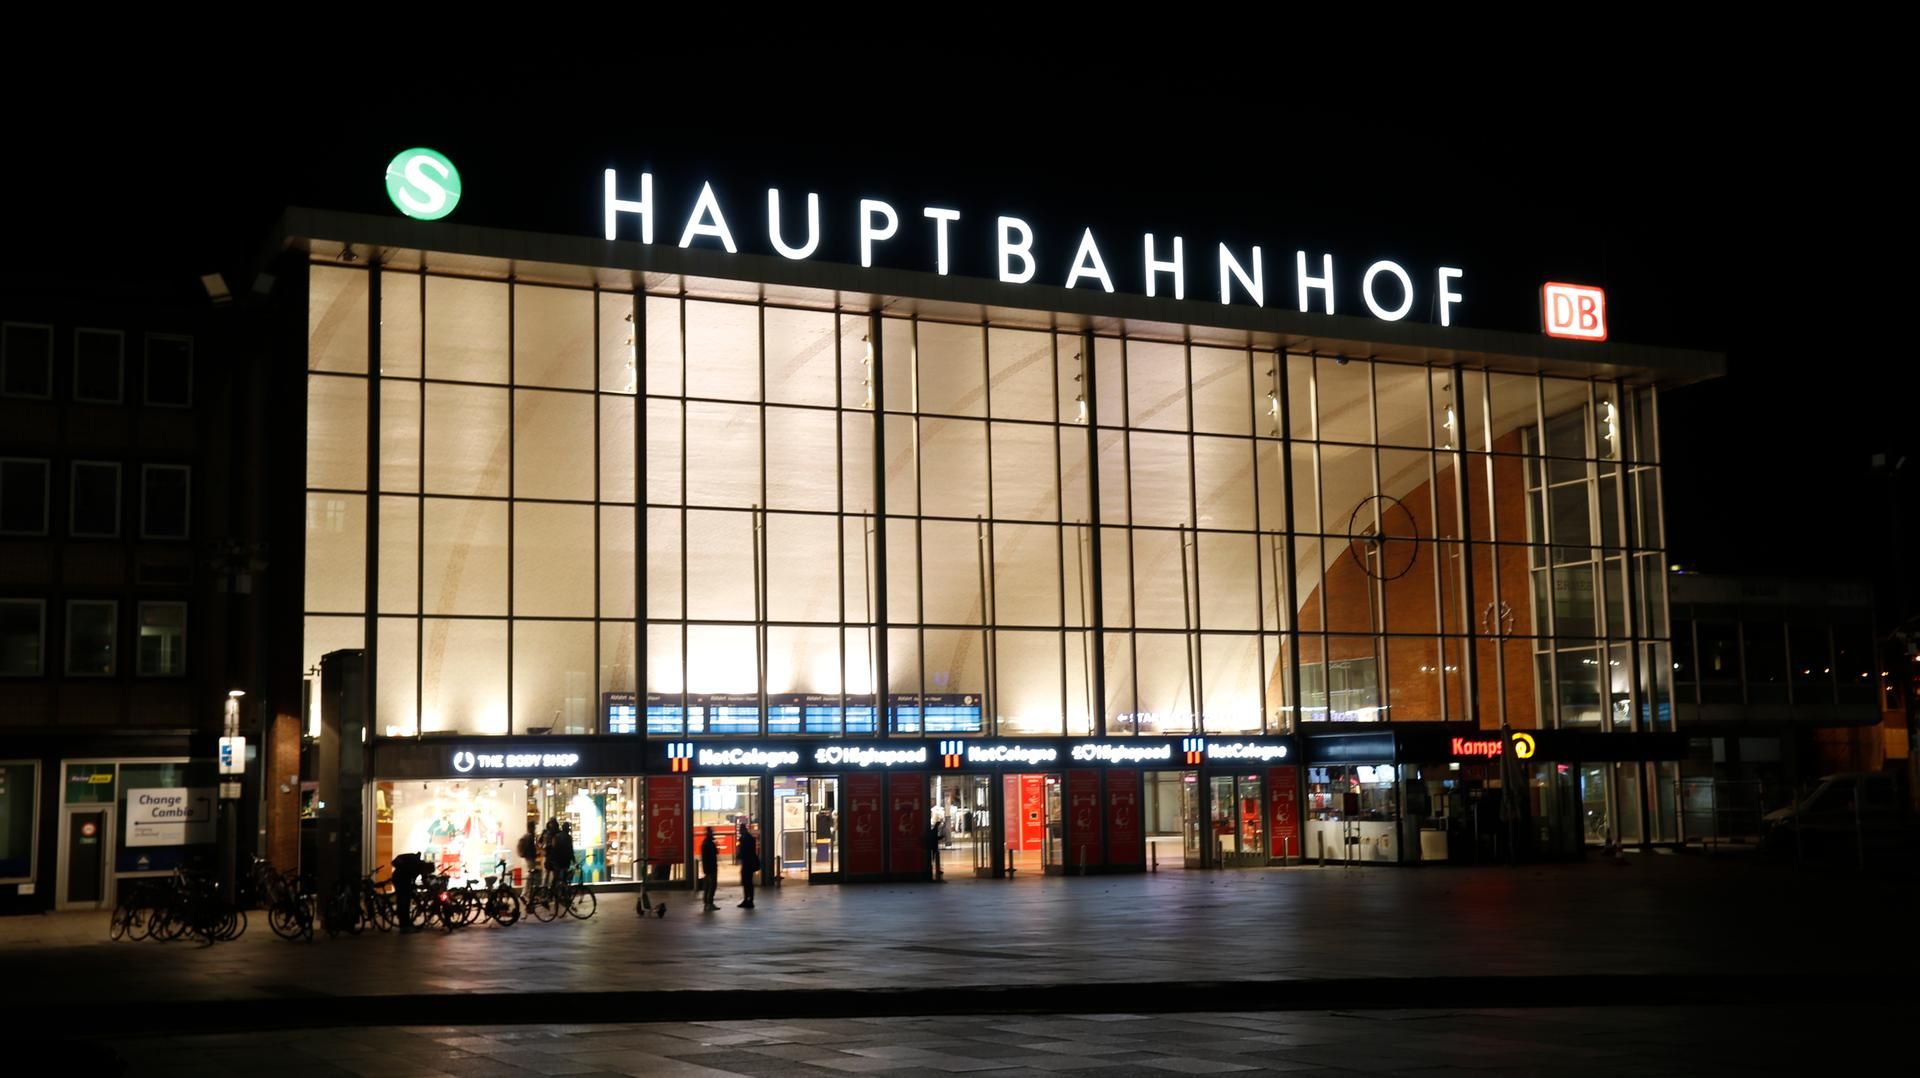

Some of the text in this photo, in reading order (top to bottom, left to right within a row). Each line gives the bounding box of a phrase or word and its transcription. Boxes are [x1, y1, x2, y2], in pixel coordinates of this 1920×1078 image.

[399, 154, 449, 213] S
[603, 168, 1464, 327] HAUPTBAHNHOF
[1553, 293, 1598, 330] DB
[968, 745, 1056, 764] NetCologne
[1207, 743, 1287, 761] NetCologne
[1452, 737, 1503, 758] Kamps
[477, 753, 579, 768] THE BODY SHOP
[699, 748, 798, 768] NetCologne
[139, 794, 182, 807] Change
[151, 806, 194, 818] Cambio
